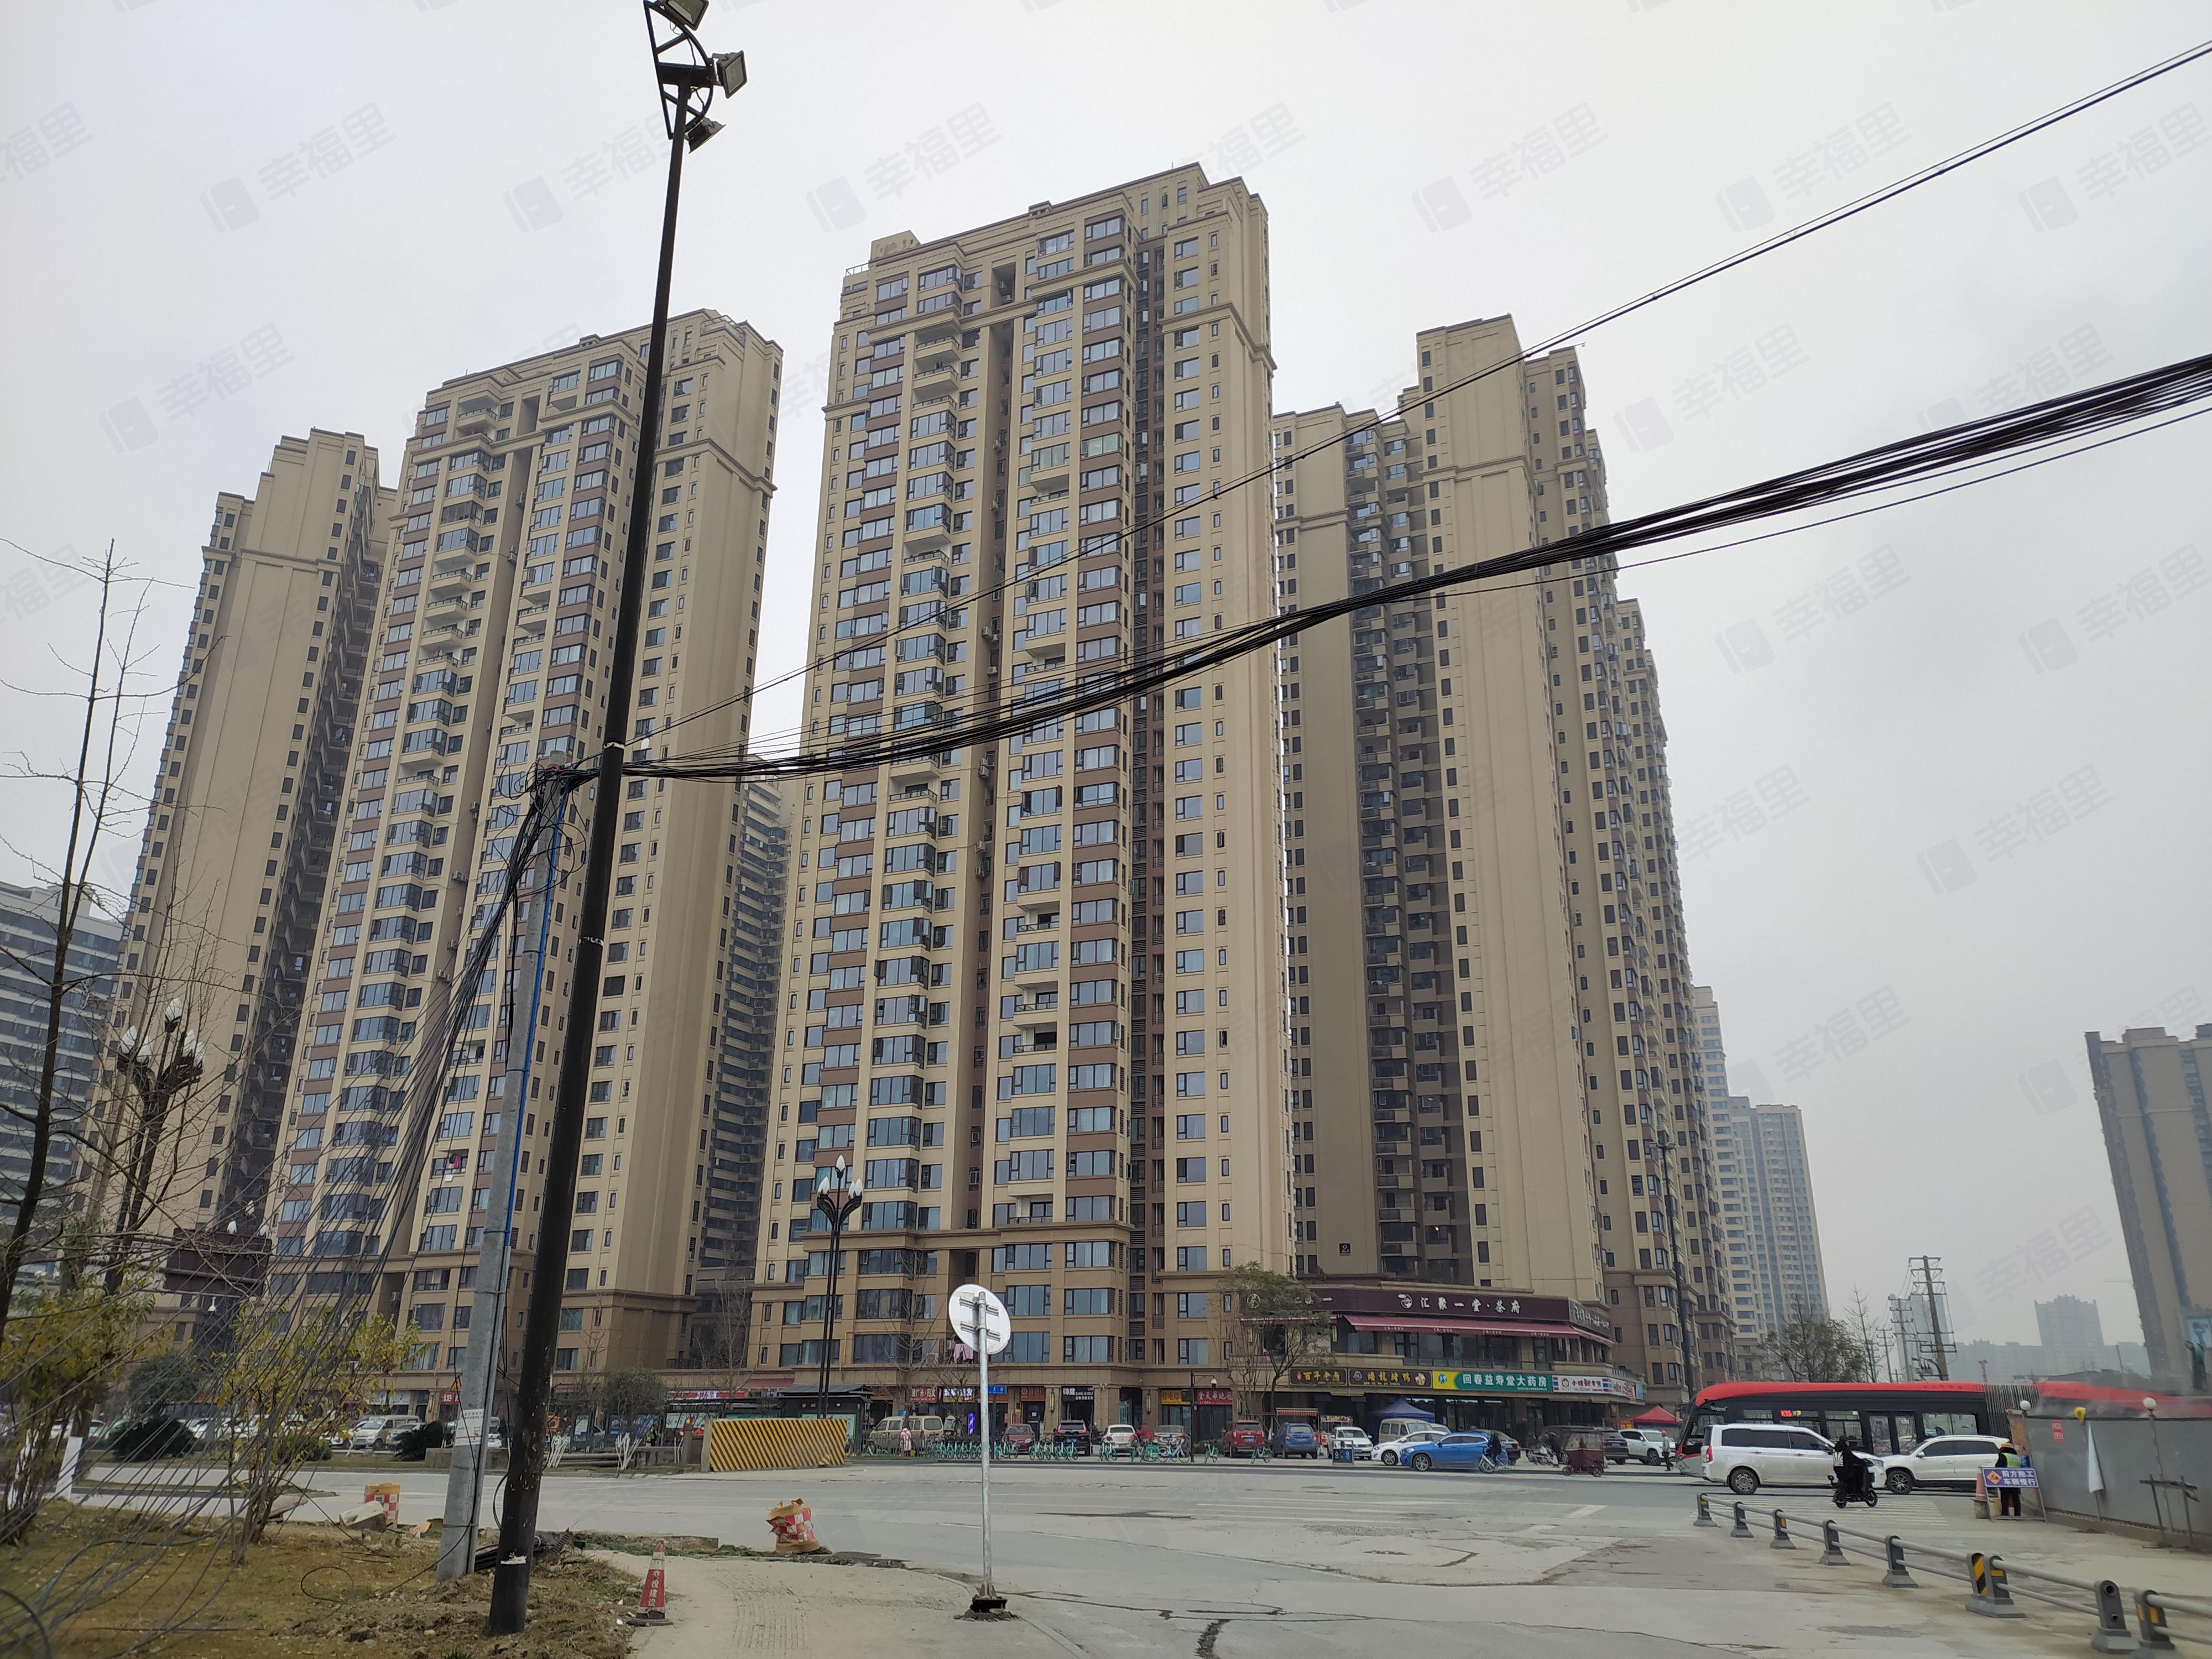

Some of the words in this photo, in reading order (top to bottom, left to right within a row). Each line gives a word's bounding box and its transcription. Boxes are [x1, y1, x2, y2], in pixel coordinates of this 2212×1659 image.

[1463, 1374, 1547, 1387] 回春益寿堂大药房
